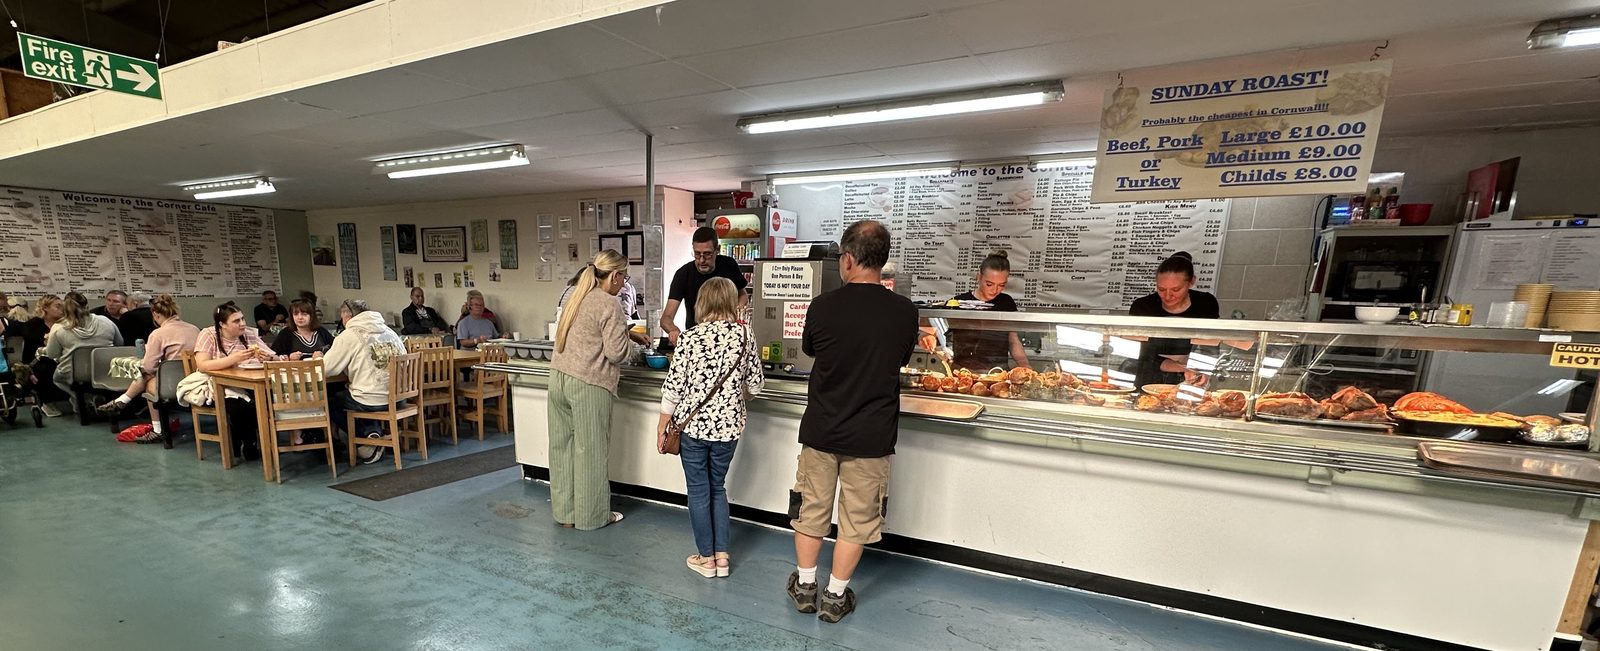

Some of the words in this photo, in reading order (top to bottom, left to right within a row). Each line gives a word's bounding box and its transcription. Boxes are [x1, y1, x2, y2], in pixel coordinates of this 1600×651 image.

[27, 38, 74, 64] Fire
[32, 60, 78, 82] exit
[1151, 80, 1236, 101] SUNDAY
[1241, 70, 1329, 91] ROAST!
[1141, 116, 1185, 128] Probably
[1188, 114, 1205, 123] the
[1207, 110, 1254, 122] cheapest
[1256, 108, 1267, 116] in
[1270, 103, 1330, 115] Cornwall!!
[1220, 130, 1281, 146] Large
[1288, 121, 1366, 138] £10.00
[1107, 139, 1150, 153] Beef,
[1157, 134, 1204, 148] Pork
[1140, 157, 1162, 169] or
[1205, 149, 1291, 165] Medium
[1298, 143, 1362, 159] £9.00
[982, 168, 996, 176] to
[1002, 166, 1023, 174] the
[1220, 168, 1287, 183] Childs
[1294, 165, 1358, 180] £8.00
[1116, 176, 1181, 190] Turkey
[63, 193, 116, 204] Welcome
[120, 198, 133, 206] to
[136, 199, 152, 207] the
[156, 201, 192, 211] Corner
[427, 235, 441, 248] LIFE
[1559, 355, 1600, 365] HOT
